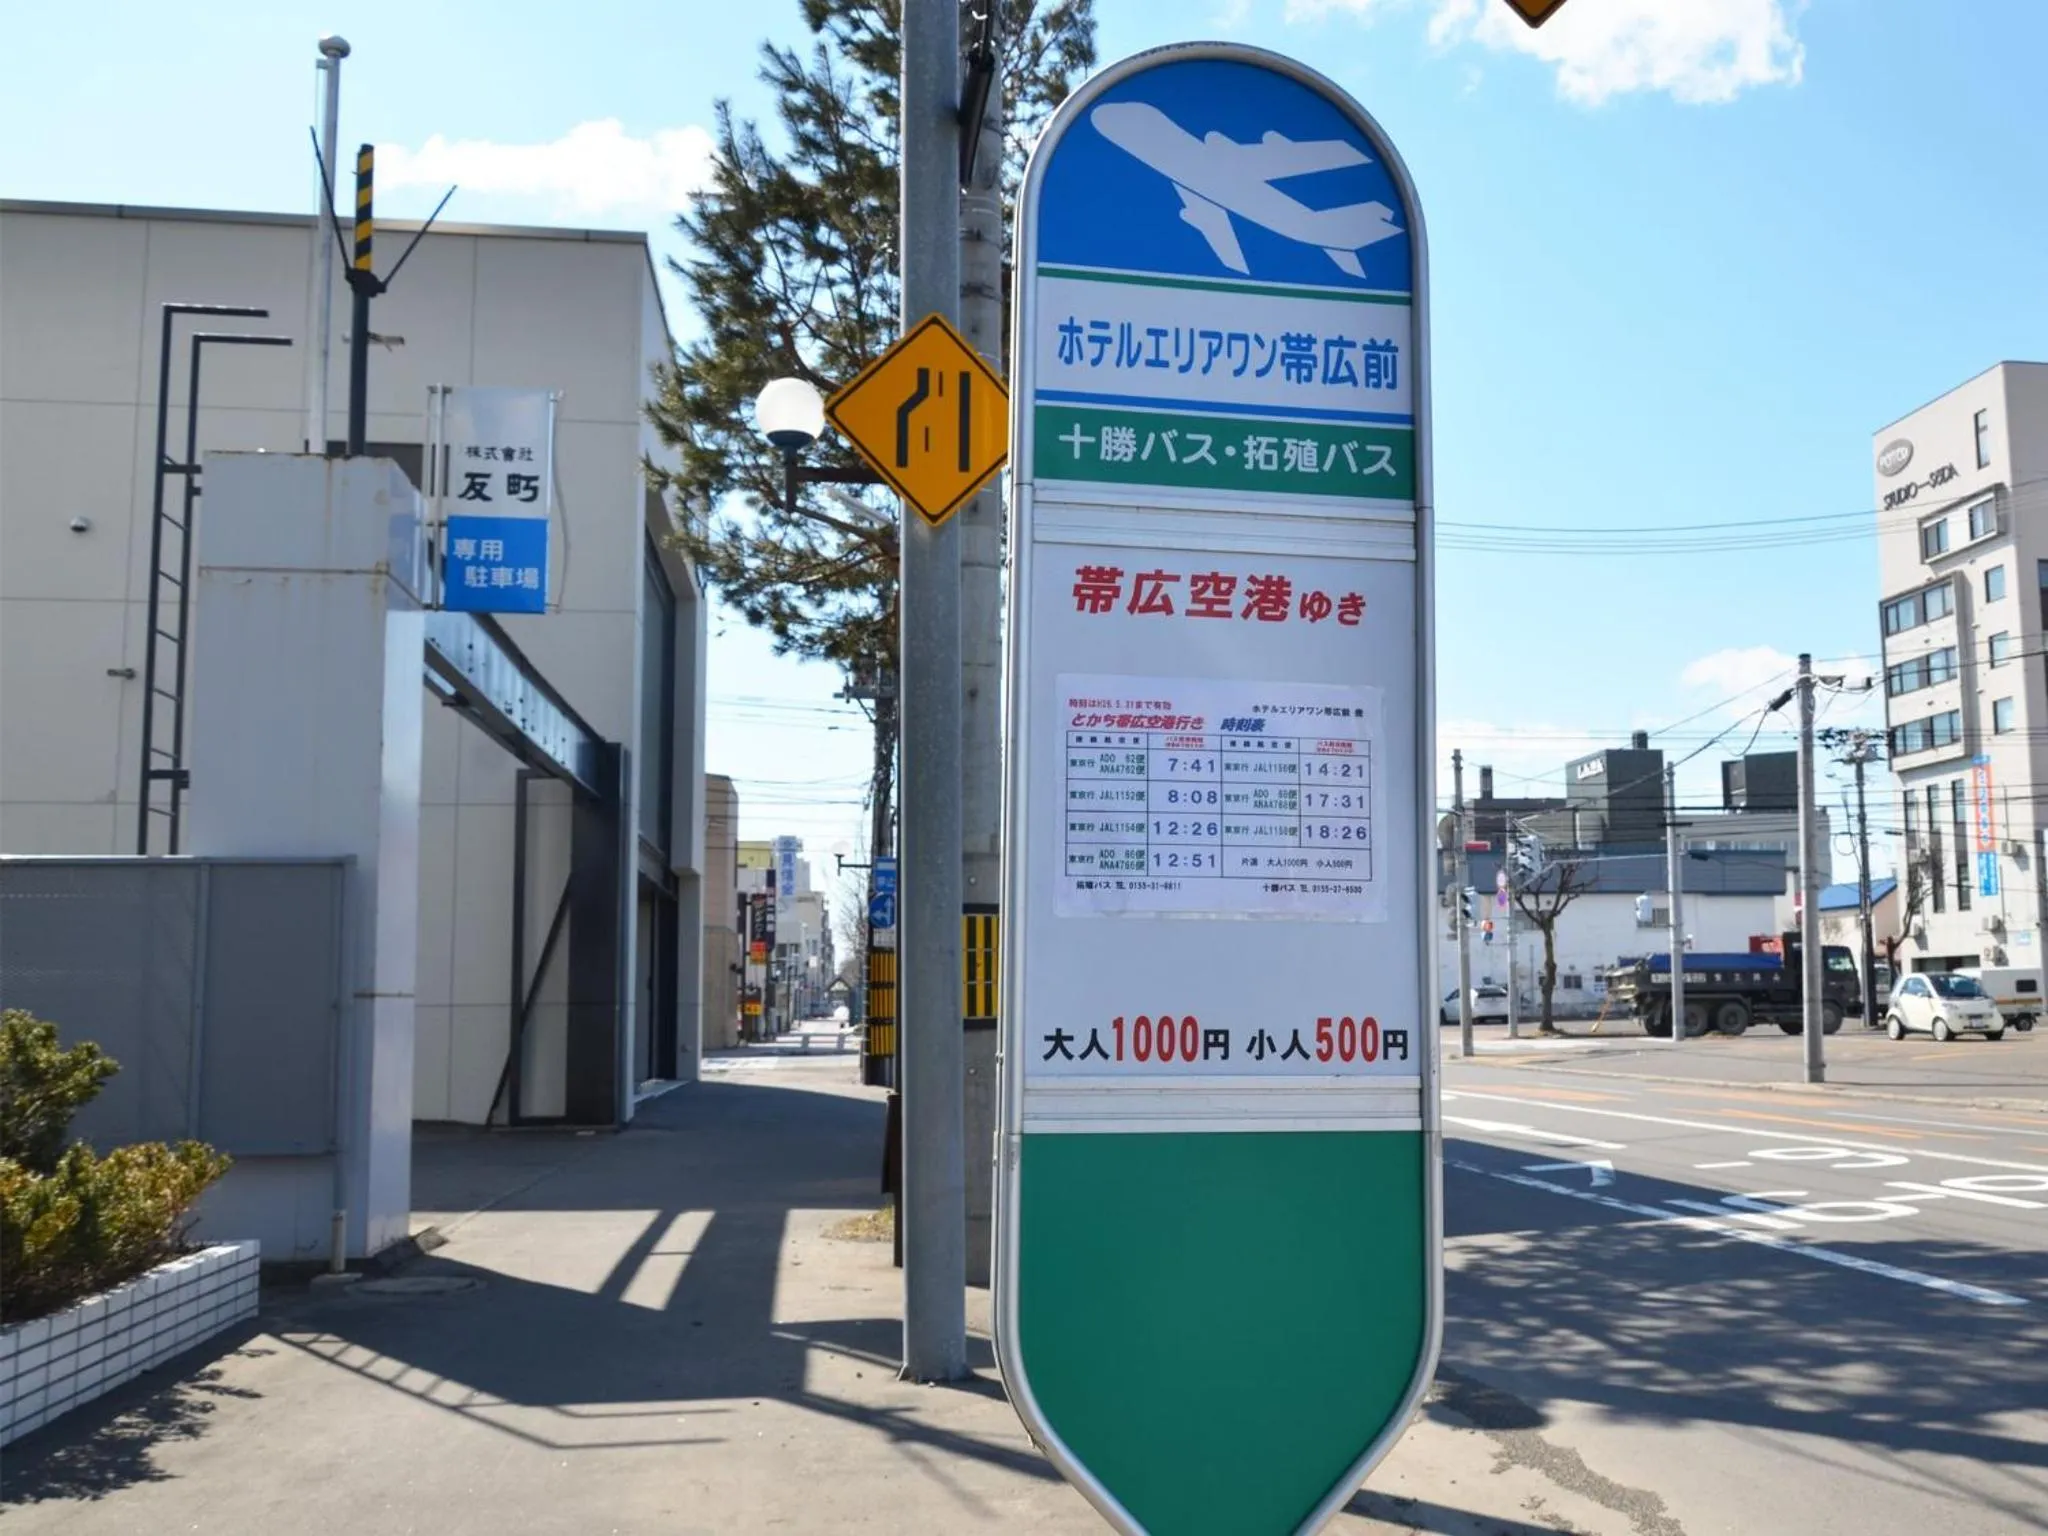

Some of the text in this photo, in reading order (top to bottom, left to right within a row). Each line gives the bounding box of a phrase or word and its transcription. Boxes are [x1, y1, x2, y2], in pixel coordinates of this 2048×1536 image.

[1058, 316, 1398, 390] ホテルエリアワン帯広前
[1059, 423, 1396, 476] 十勝バス・拓殖バス
[453, 539, 504, 561] 専用
[465, 566, 539, 589] 駐車場
[1073, 565, 1366, 626] 帯広空港ゆき
[1071, 713, 1266, 732] とかち帯広空港行き 時刻表
[1168, 758, 1215, 772] 7:41
[1305, 763, 1363, 779] 14:21
[1168, 790, 1217, 803] 8:08
[1305, 795, 1363, 809] 17:31
[1153, 822, 1218, 835] 12:26
[1305, 826, 1366, 839] 18:26
[1153, 853, 1215, 867] 12:51
[1043, 1016, 1408, 1062] 大人1000円 小人500円
